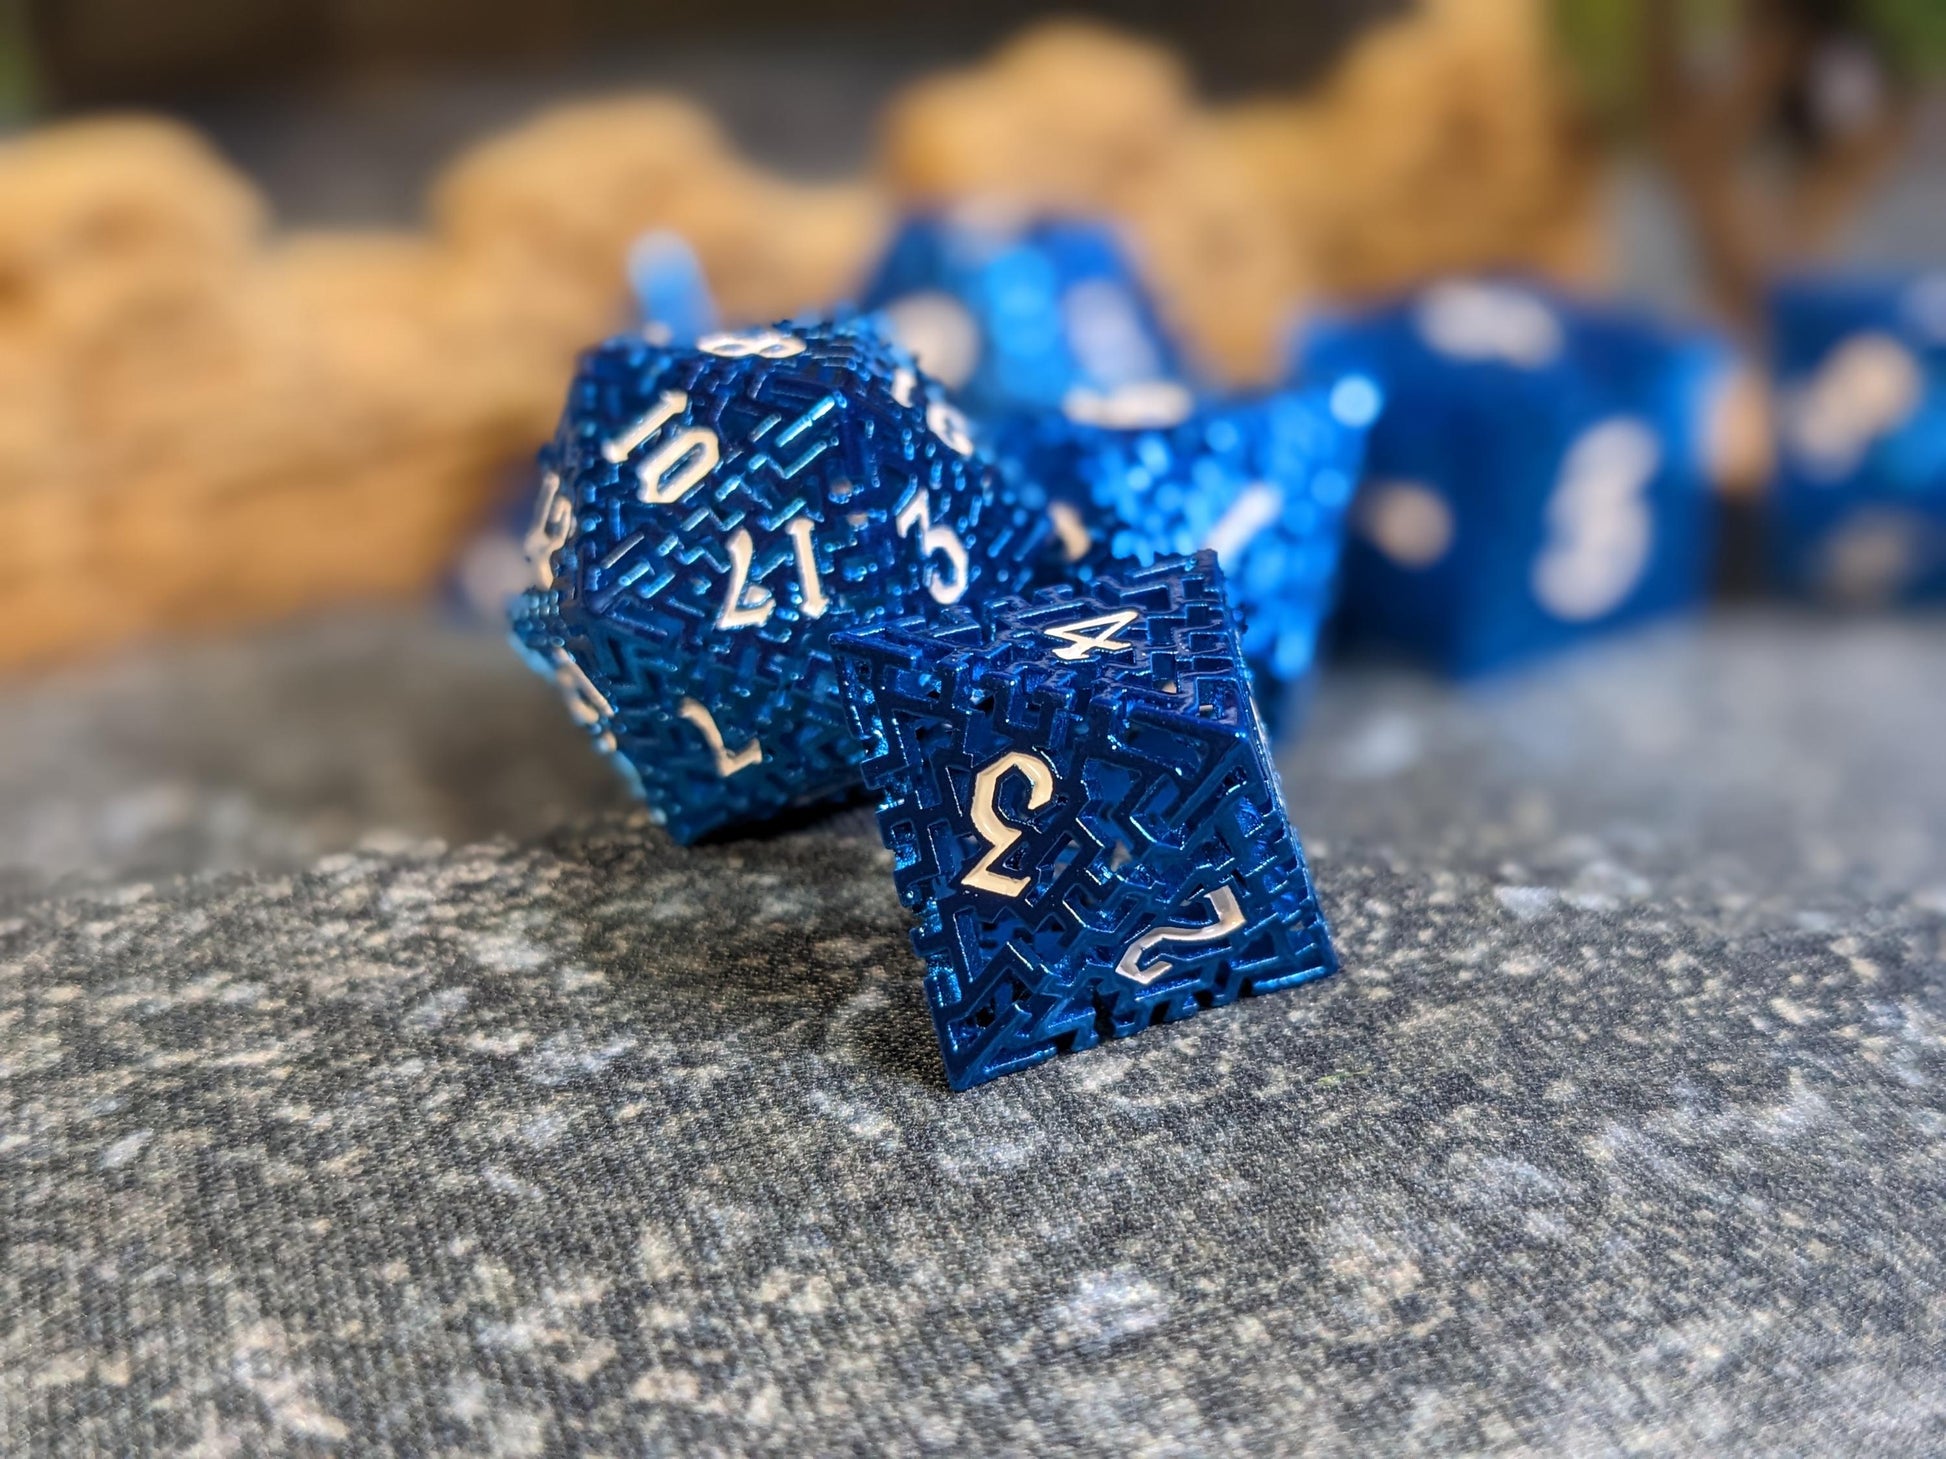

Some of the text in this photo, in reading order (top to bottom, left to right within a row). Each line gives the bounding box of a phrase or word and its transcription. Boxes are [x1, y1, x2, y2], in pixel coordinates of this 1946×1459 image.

[697, 331, 807, 359] 8
[604, 391, 720, 504] 10
[714, 518, 829, 629] 17
[896, 490, 968, 606] 3
[1044, 609, 1139, 661] 4
[679, 697, 763, 777] 7
[960, 751, 1055, 898] 3
